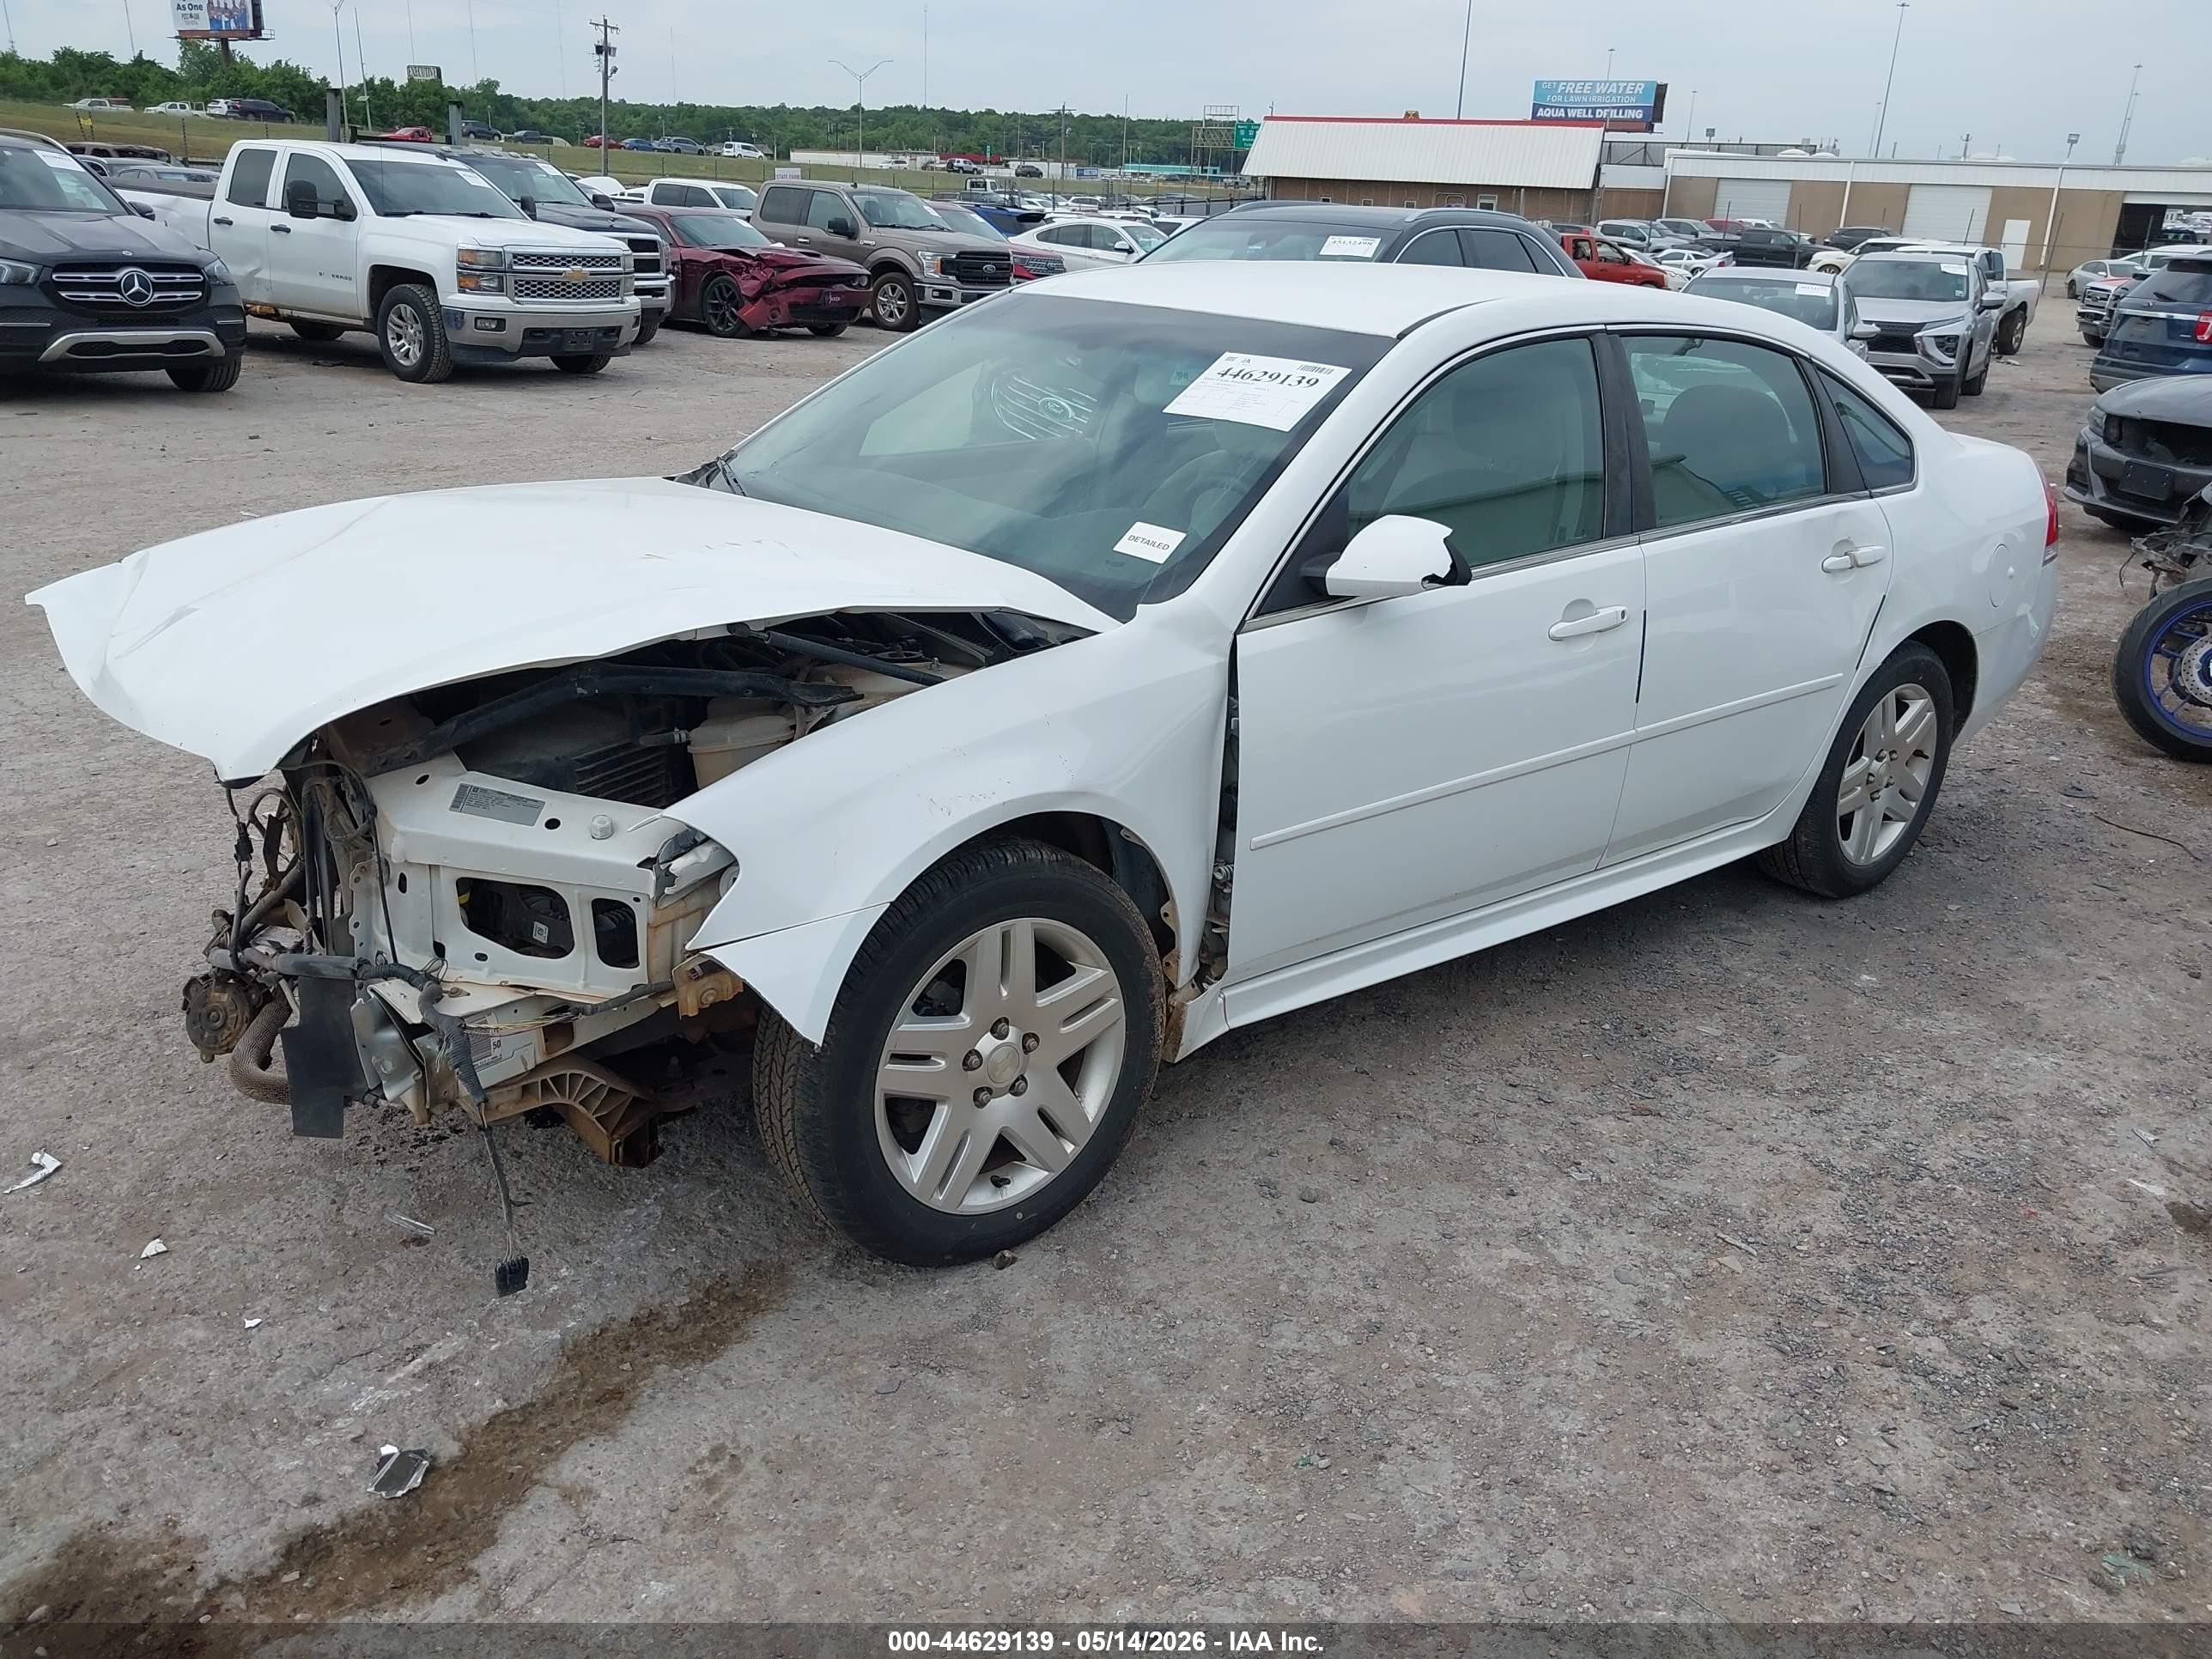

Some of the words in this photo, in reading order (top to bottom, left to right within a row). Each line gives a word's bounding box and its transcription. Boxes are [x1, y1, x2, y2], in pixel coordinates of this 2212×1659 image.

[1558, 82, 1592, 94] FREE
[1595, 82, 1644, 94] WATER
[1536, 108, 1565, 118] AQUA
[1567, 108, 1594, 118] WELL
[1217, 367, 1320, 388] 44629139
[1127, 534, 1170, 550] DETAILED
